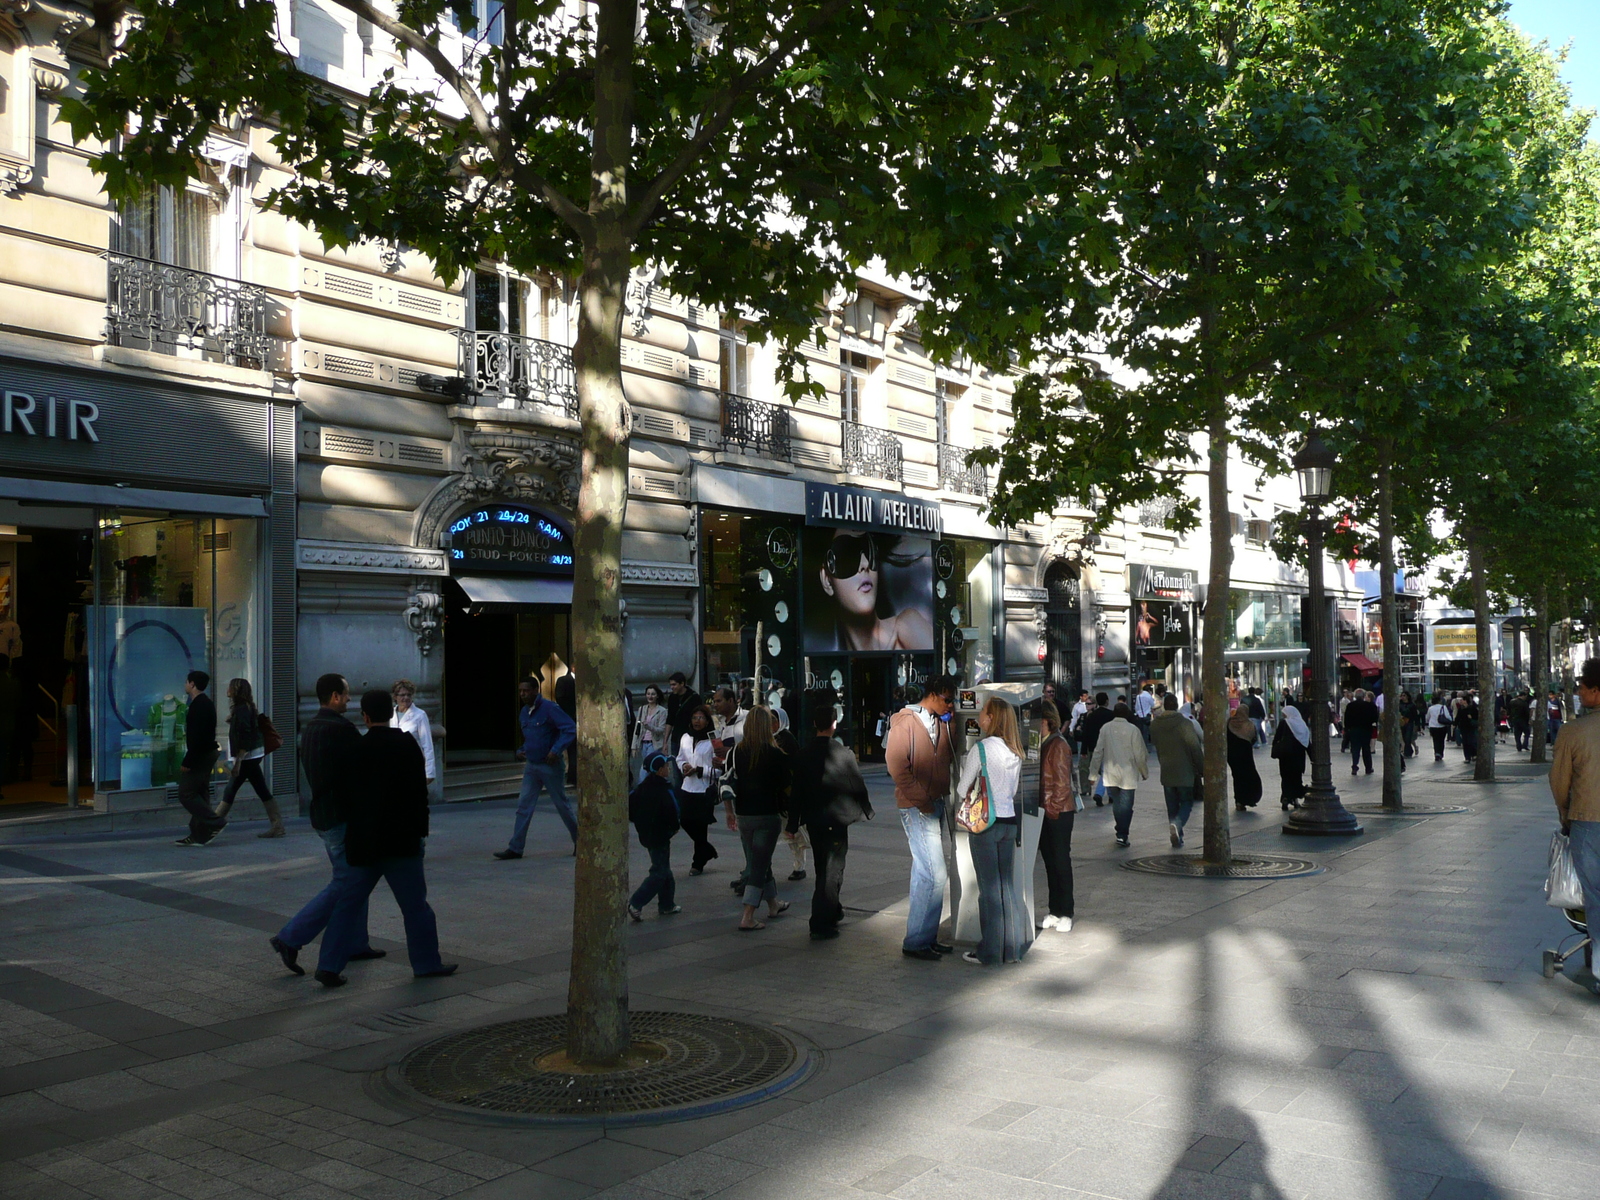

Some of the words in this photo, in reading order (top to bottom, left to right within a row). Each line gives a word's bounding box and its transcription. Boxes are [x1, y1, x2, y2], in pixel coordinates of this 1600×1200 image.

[4, 390, 100, 443] RIR
[821, 491, 873, 523] ALAIN
[882, 499, 940, 533] AFFLELOU
[804, 671, 829, 691] Dior
